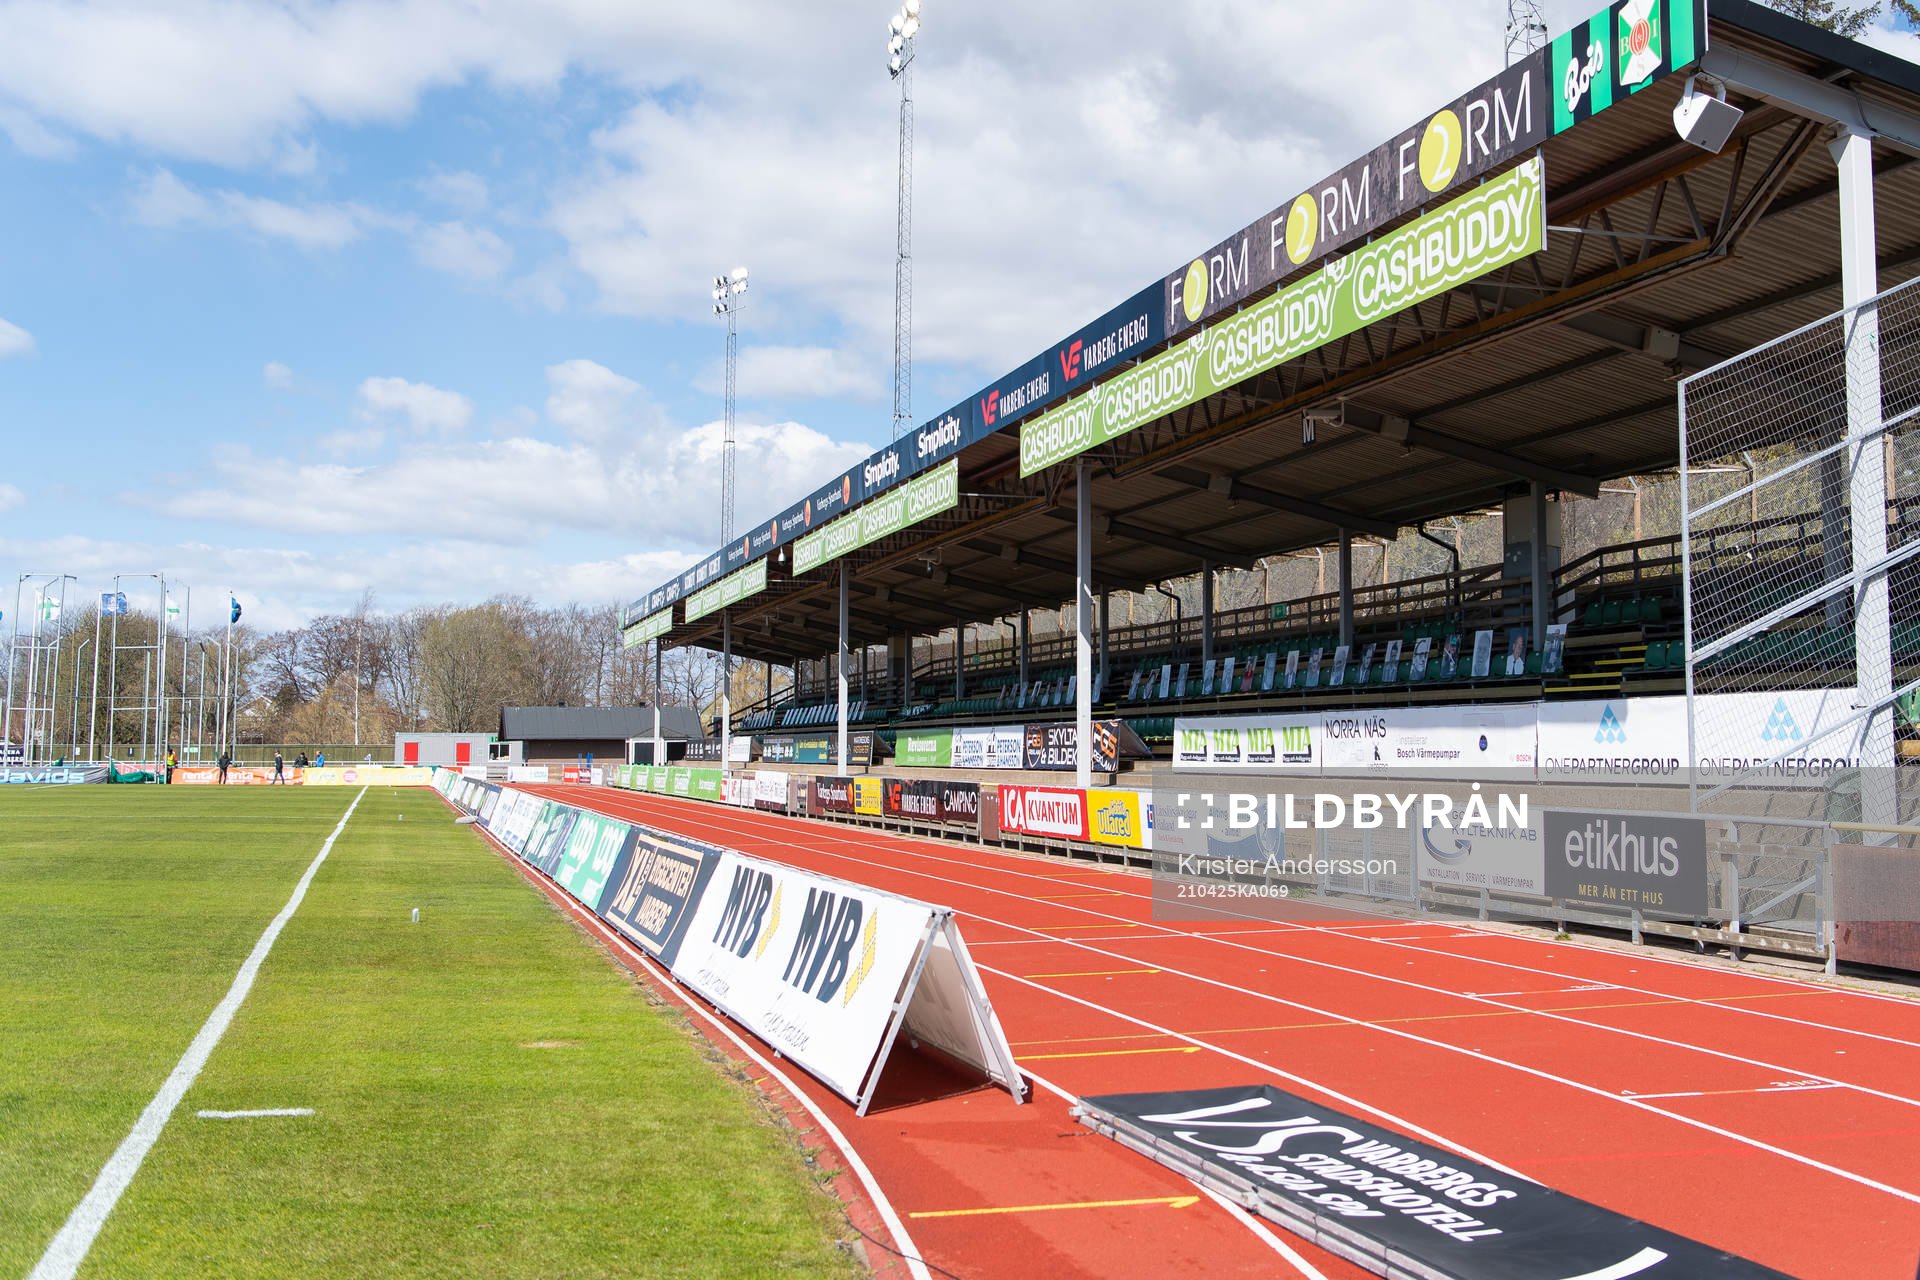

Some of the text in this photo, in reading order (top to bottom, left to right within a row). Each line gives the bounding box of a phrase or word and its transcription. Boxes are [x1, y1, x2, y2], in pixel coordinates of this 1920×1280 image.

[1564, 40, 1603, 112] Bois
[1358, 187, 1528, 307] CASHBUDDY
[1083, 332, 1116, 371] VARBERG
[1118, 313, 1149, 352] ENERGI
[1213, 283, 1333, 375] CASHBUDDY
[999, 386, 1025, 419] VARBERG
[1026, 372, 1050, 404] ENERGI
[1105, 353, 1197, 420] CASHBUDDY
[1023, 404, 1094, 465] CASHBUDDY
[908, 472, 955, 515] CASHBUDDY
[1325, 715, 1386, 738] NORRA NÄS
[1397, 748, 1415, 759] Bosch
[1545, 758, 1680, 776] ONEPARTNERGROUP
[902, 793, 919, 813] VARBERG
[944, 790, 977, 814] CAMPINO
[1003, 788, 1079, 830] ICA KVANTUM
[1520, 829, 1537, 841] AB
[1564, 819, 1679, 877] etikhus
[1427, 867, 1460, 881] INSTALLATION
[1465, 872, 1487, 884] SERVICE
[1578, 884, 1664, 905] MER ÄN ETT HUS
[712, 864, 773, 959] MVB
[782, 886, 864, 1004] MVB
[1341, 1138, 1518, 1207] VARBERGS
[1278, 1152, 1503, 1242] STADSHOTELL
[1297, 1190, 1386, 1217] SPA
